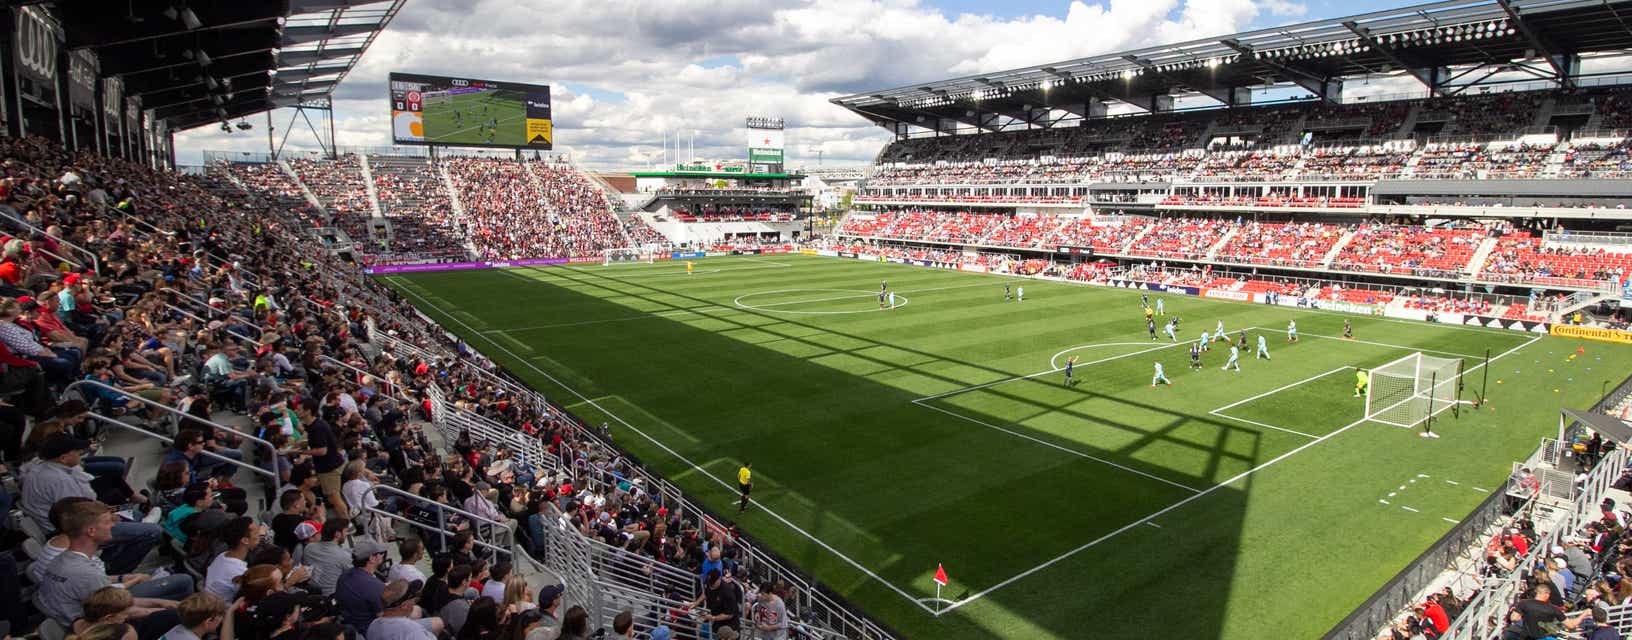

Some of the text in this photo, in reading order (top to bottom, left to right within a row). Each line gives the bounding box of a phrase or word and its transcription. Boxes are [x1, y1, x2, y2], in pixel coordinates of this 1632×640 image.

[397, 102, 404, 110] 0
[411, 103, 418, 111] 0
[1554, 325, 1612, 339] Continental
